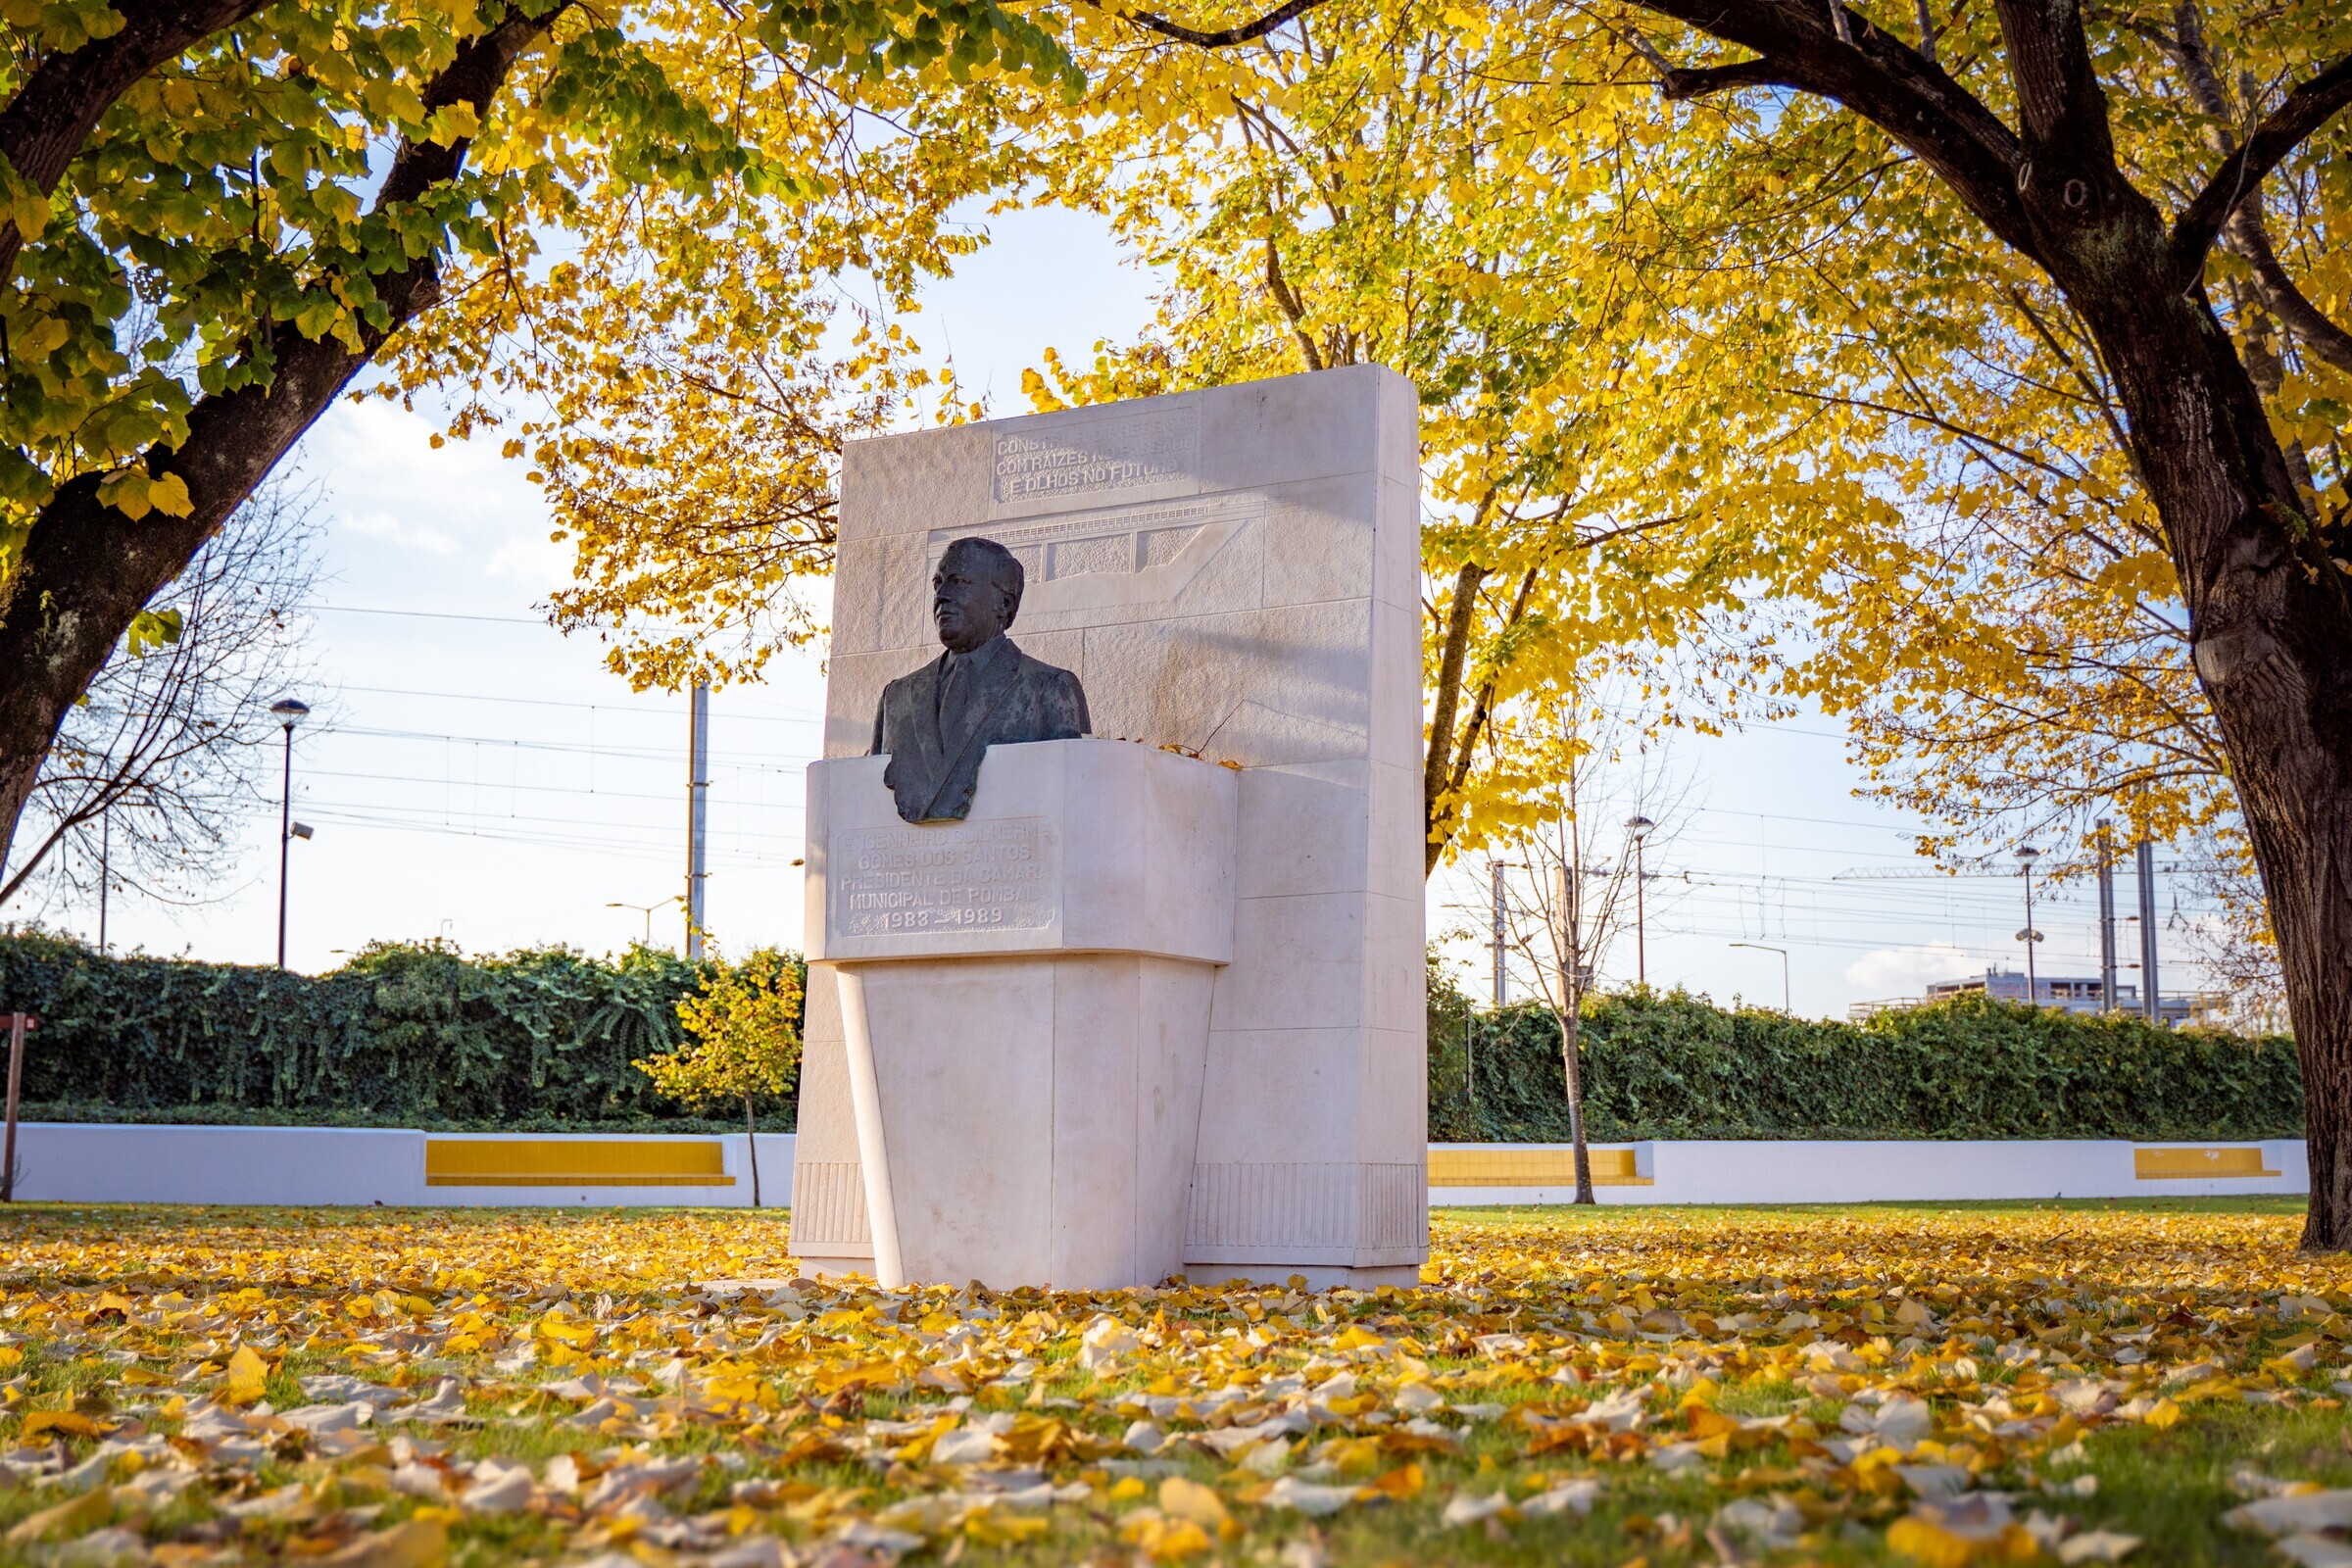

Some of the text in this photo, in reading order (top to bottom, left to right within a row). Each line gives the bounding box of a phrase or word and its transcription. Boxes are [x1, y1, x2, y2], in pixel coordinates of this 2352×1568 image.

[997, 457, 1028, 475] COM
[1093, 446, 1115, 463] NO
[1010, 459, 1178, 494] E OLHOS NO FUTURO
[845, 822, 1052, 852] ENGENHEIRO GUILHERME
[858, 844, 1032, 871] GOMES DOS SANTOS
[841, 870, 946, 892] PRESIDENTE
[952, 868, 974, 886] DA
[850, 885, 1039, 911] MUNICIPAL DE POMBAL
[883, 911, 930, 929] 1983
[956, 906, 1004, 925] 1989
